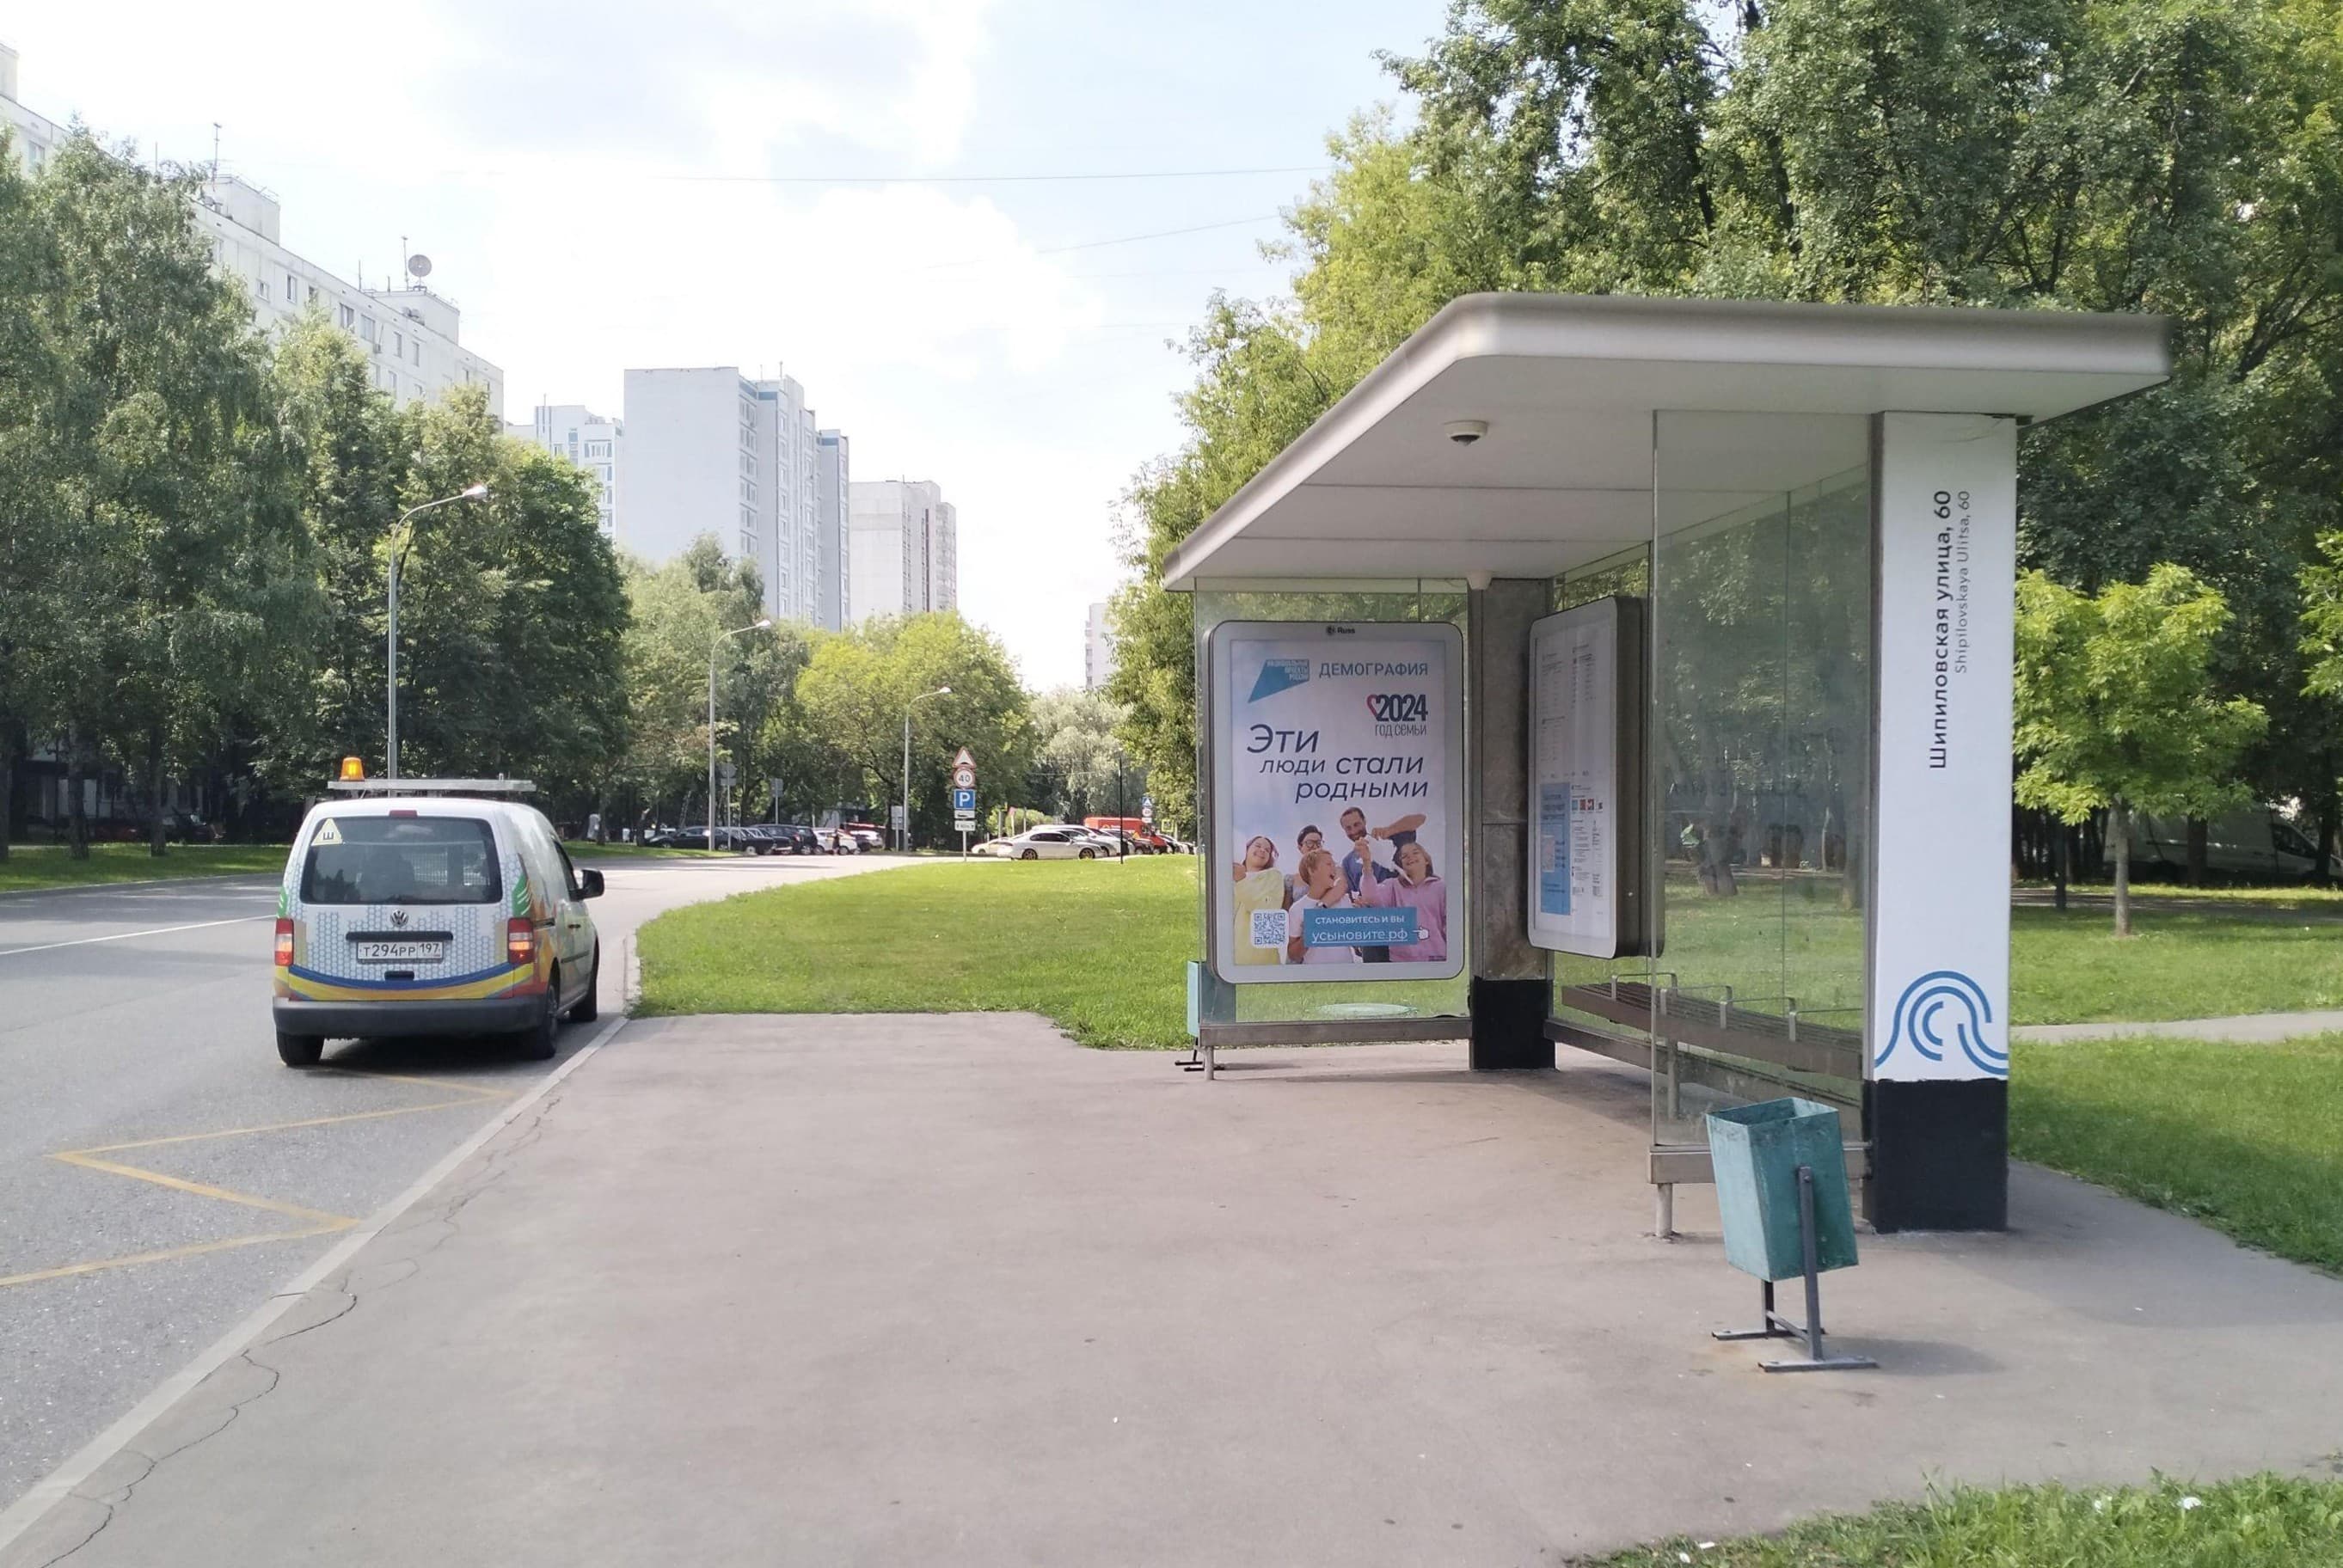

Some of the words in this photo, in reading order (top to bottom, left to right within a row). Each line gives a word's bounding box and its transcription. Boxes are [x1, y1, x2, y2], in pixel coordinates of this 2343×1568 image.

[1934, 490, 1951, 519] 60
[1958, 491, 1970, 511] 60
[1956, 515, 1971, 562] Ulitsa,
[1937, 526, 1954, 601] улица,
[1954, 567, 1971, 673] Shipilovskaya
[1319, 662, 1428, 678] ДЕМОГРАФИЯ
[1929, 609, 1950, 769] Шипиловская
[1375, 694, 1428, 722] 2024
[1247, 724, 1319, 753] Эти
[1260, 760, 1326, 775] люди
[1336, 756, 1424, 775] стали
[958, 775, 971, 783] 40
[959, 792, 971, 807] P
[1295, 781, 1428, 804] родными
[322, 832, 334, 841] Ш
[1315, 916, 1380, 925] СТАНОВИТЕСЬ
[1312, 928, 1408, 943] усыновите.рф
[420, 943, 439, 953] 197
